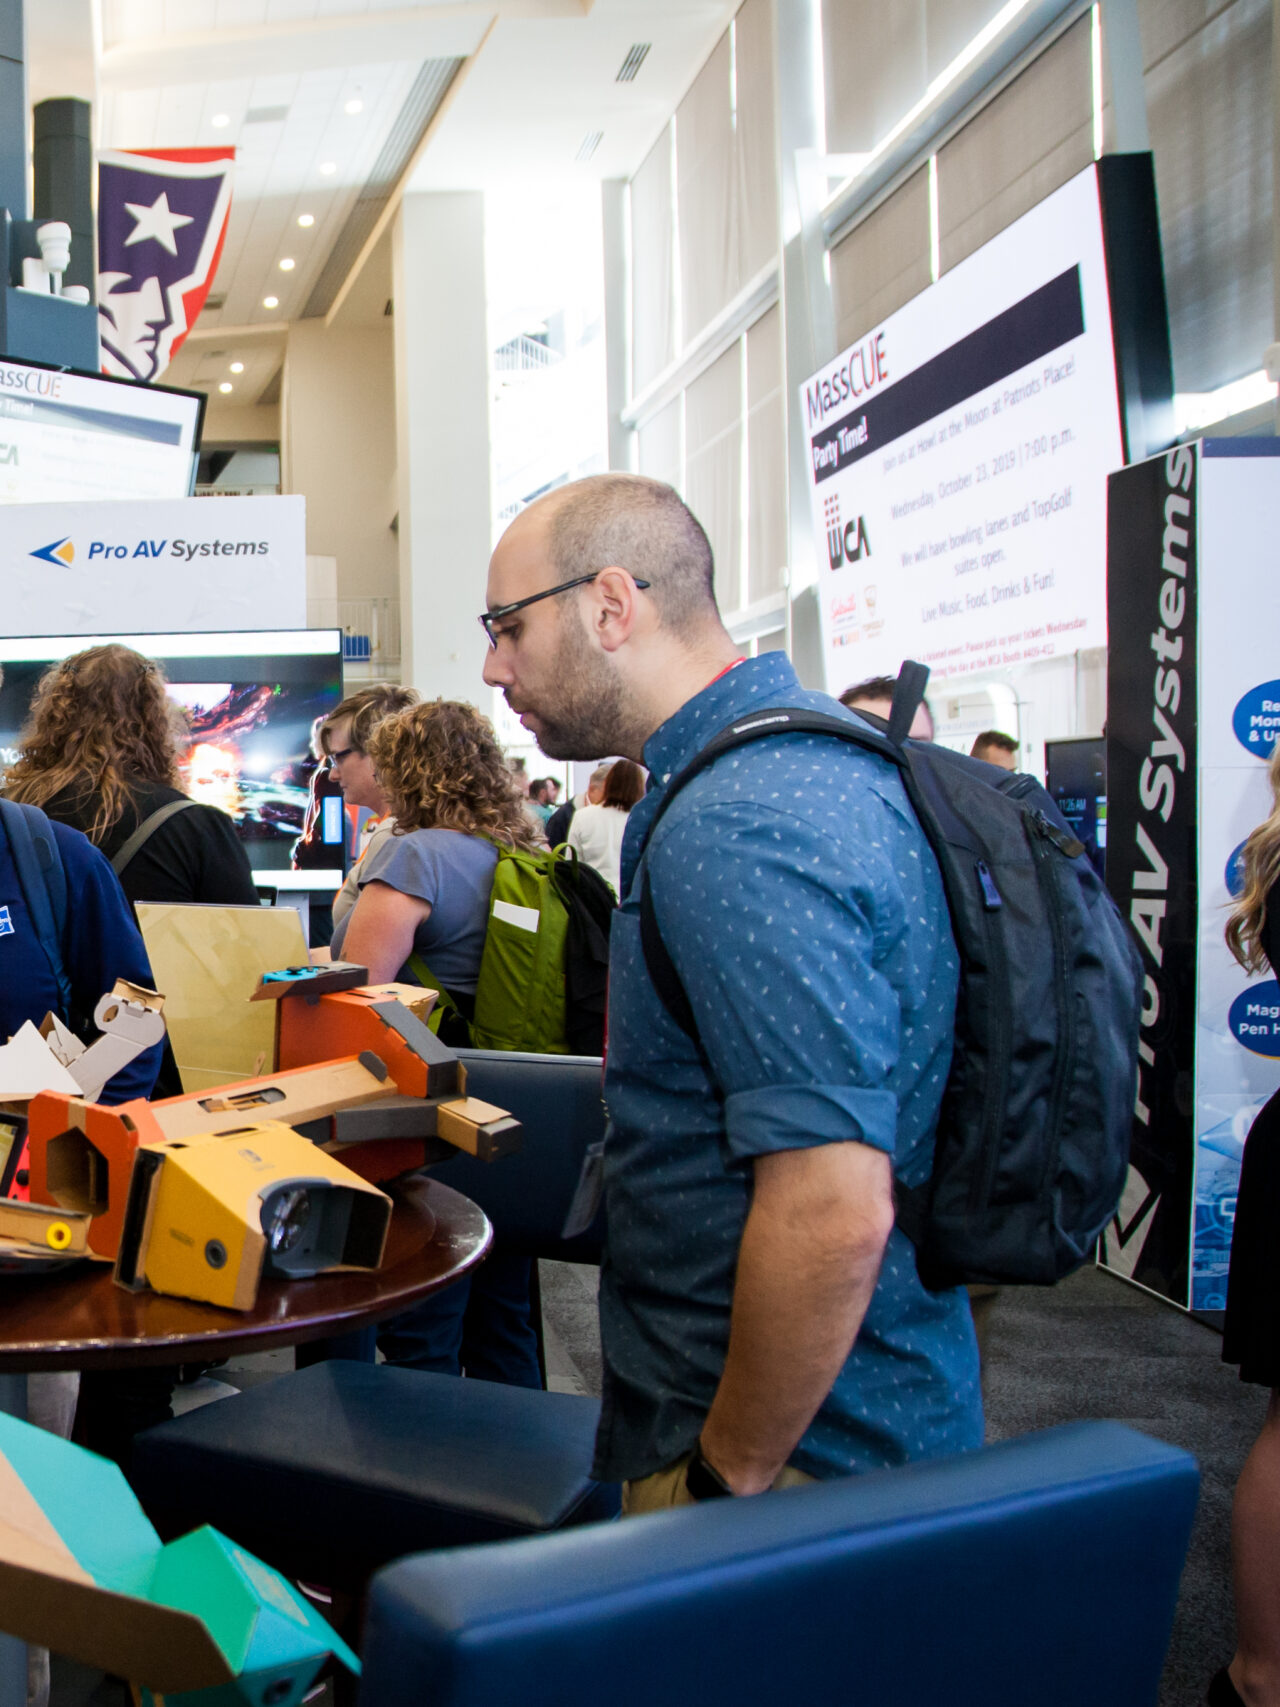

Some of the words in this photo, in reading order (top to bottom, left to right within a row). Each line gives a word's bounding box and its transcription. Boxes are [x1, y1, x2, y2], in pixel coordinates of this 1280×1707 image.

[806, 330, 888, 429] MassCUE
[1043, 354, 1076, 387] Place!
[813, 439, 838, 471] Party
[837, 415, 869, 456] Time!
[1011, 505, 1030, 528] and
[1032, 485, 1073, 519] TopGolf
[88, 541, 128, 560] Pro
[132, 540, 167, 558] AV
[170, 539, 269, 561] Systems
[827, 514, 872, 571] WCA
[992, 580, 1021, 604] Drinks
[1023, 576, 1031, 594] &
[1139, 444, 1193, 822] Systems
[1248, 730, 1260, 742] &
[1239, 1023, 1269, 1035] Pen
